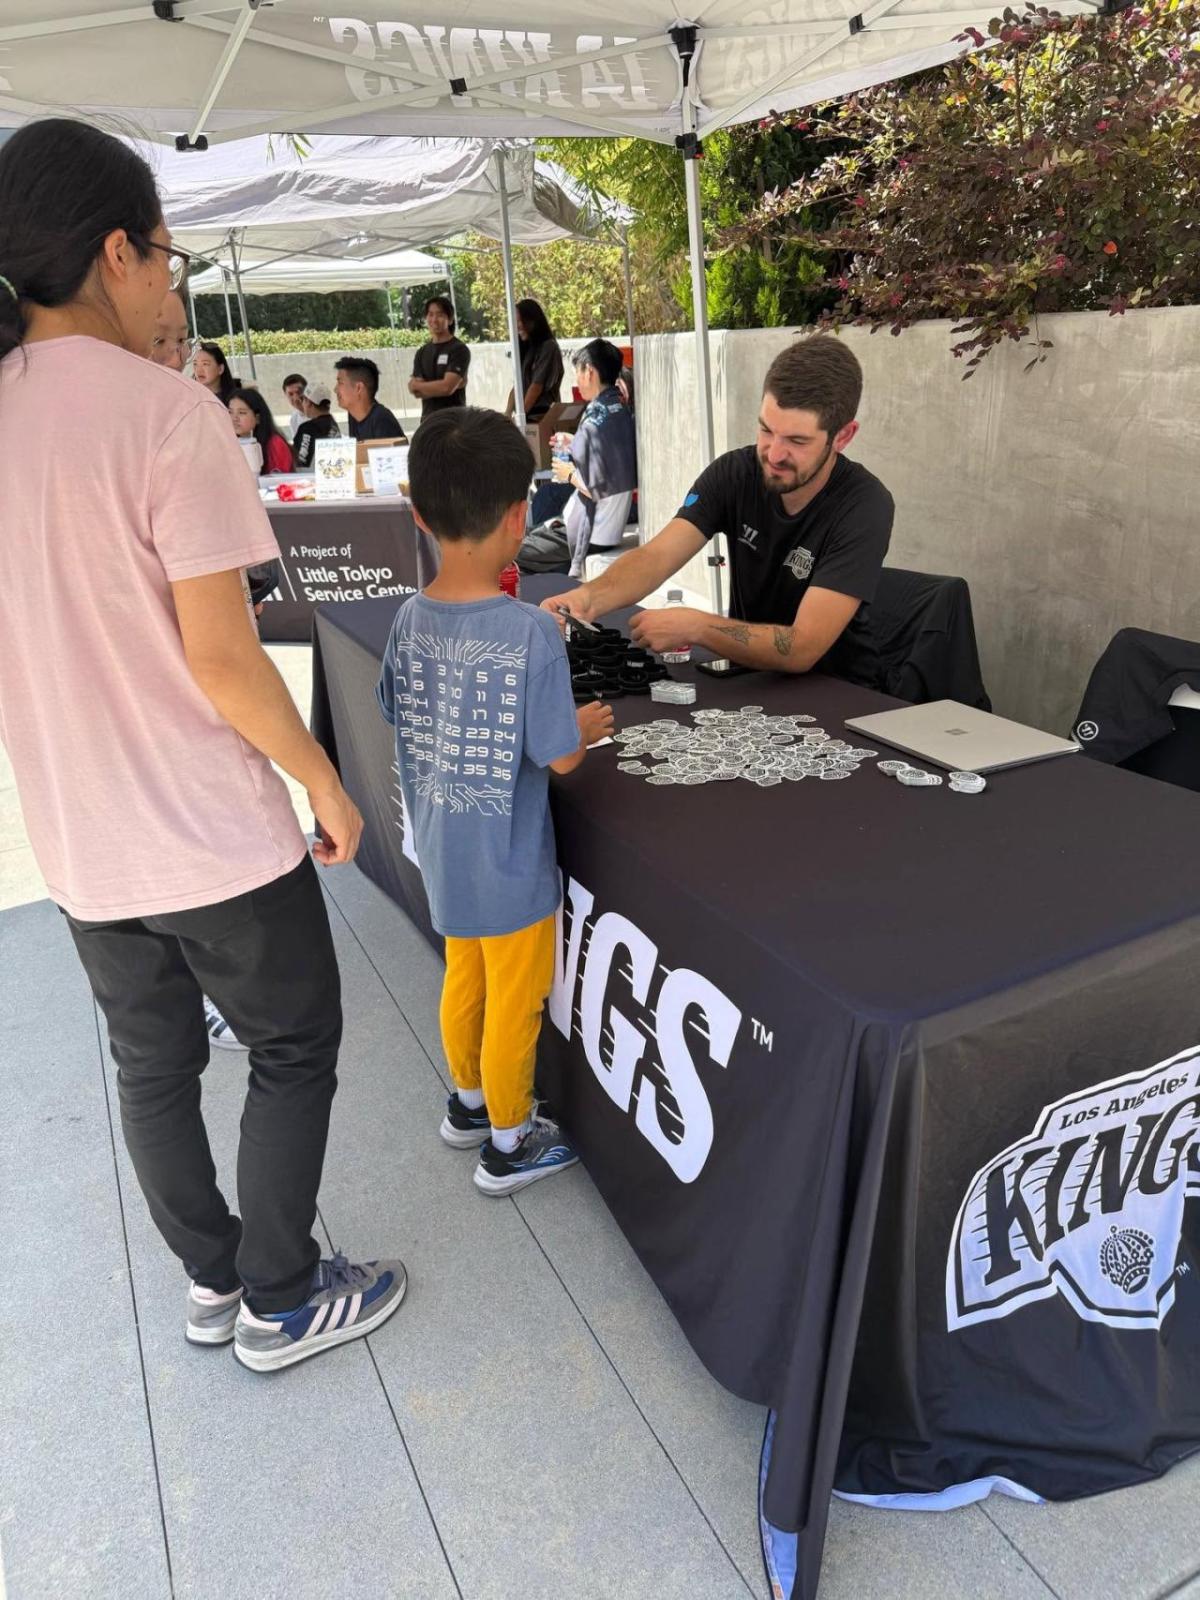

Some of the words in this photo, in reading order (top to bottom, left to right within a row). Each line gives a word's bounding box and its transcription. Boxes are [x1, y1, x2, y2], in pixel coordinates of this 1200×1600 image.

[290, 546, 299, 558] A
[300, 545, 338, 560] Project
[340, 543, 352, 559] of
[296, 566, 338, 583] Little
[338, 564, 393, 584] Tokyo
[304, 586, 364, 602] Service
[411, 661, 423, 673] 2
[437, 664, 446, 676] 3
[454, 668, 463, 680] 4
[476, 671, 488, 683] 5
[505, 674, 517, 686] 6
[413, 680, 424, 691] 8
[438, 682, 446, 694] 9
[450, 687, 462, 699] 10
[476, 690, 487, 702] 11
[500, 693, 517, 706] 12
[396, 693, 411, 704] 13
[412, 697, 428, 709] 14
[449, 705, 460, 718] 16
[472, 709, 487, 720] 17
[497, 712, 515, 725] 18
[412, 714, 433, 726] 20
[445, 722, 461, 738] 22
[465, 727, 490, 739] 23
[494, 729, 516, 745] 24
[411, 731, 434, 745] 26
[442, 741, 460, 756] 28
[464, 745, 489, 758] 29
[492, 747, 513, 763] 30
[415, 749, 434, 763] 32
[440, 760, 459, 775] 34
[463, 764, 487, 776] 35
[491, 766, 512, 781] 36
[549, 875, 743, 1184] NGS
[751, 1017, 774, 1052] TM
[1058, 1105, 1101, 1130] Los
[1103, 1072, 1189, 1117] Angeles
[1175, 1261, 1191, 1277] TM
